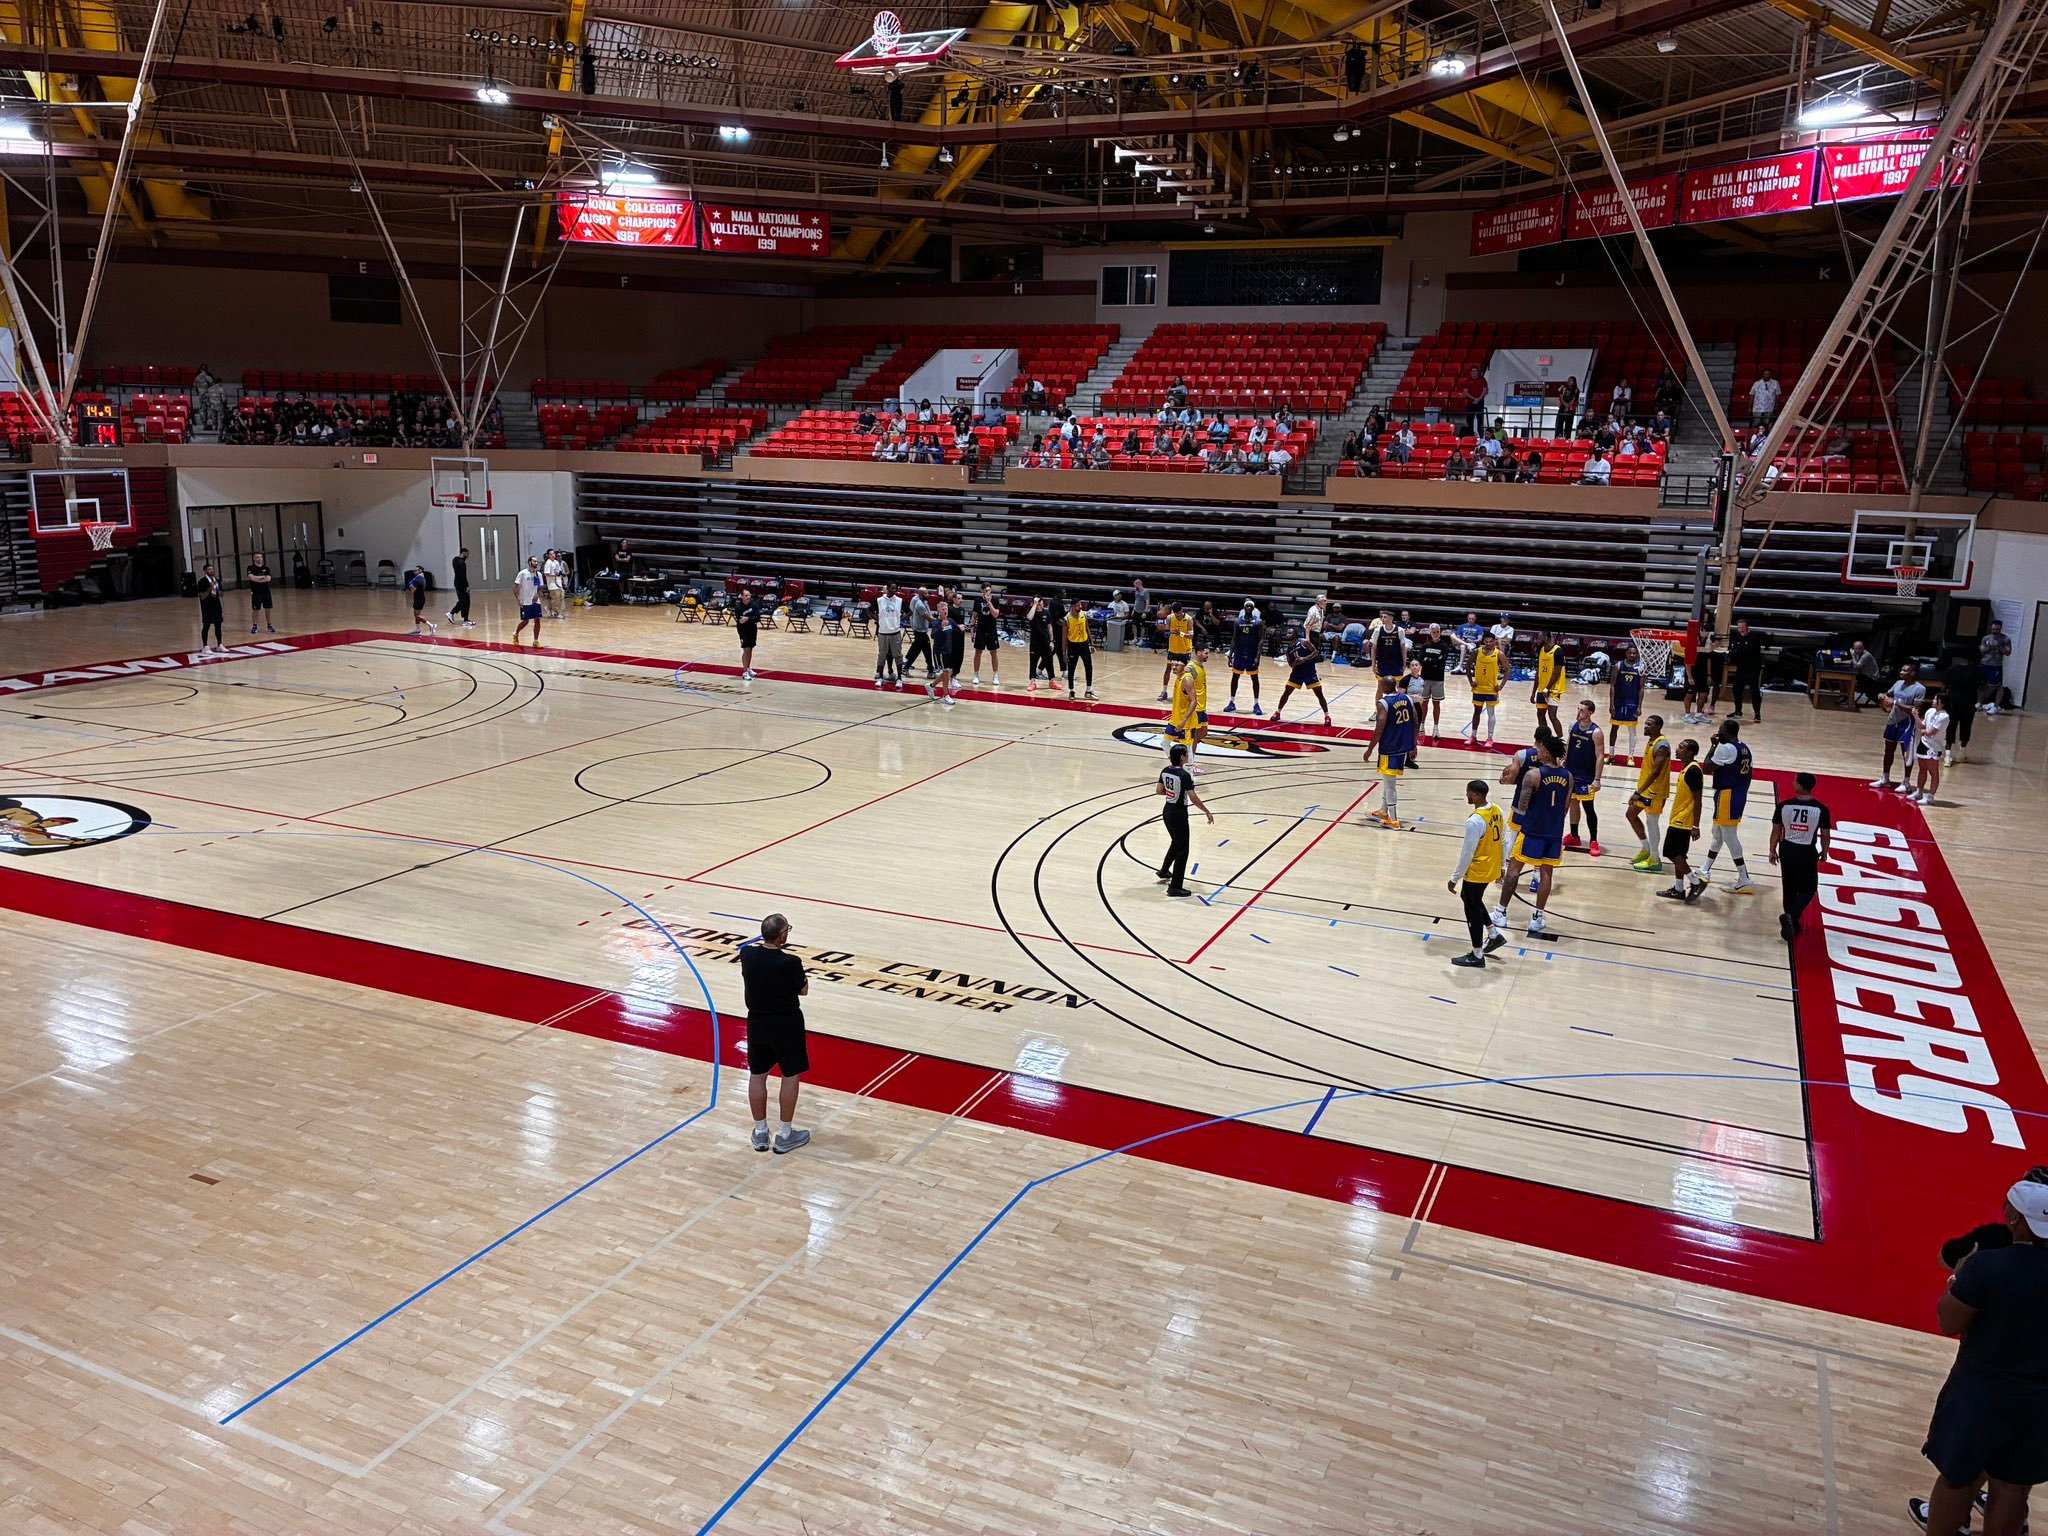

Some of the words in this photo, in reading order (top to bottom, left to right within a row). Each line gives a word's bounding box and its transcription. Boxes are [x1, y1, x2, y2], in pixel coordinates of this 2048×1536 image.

[1712, 172, 1733, 186] NAIA
[1736, 165, 1780, 182] NATIONAL
[1834, 158, 1895, 179] VOLLEYBALL
[1883, 169, 1909, 185] 1997
[1691, 184, 1742, 201] VOLLEYBALL
[1746, 175, 1801, 194] CHAMPIONS
[624, 201, 683, 214] COLLEGIATE
[1576, 203, 1618, 220] VOLLEYBALL
[578, 212, 612, 226] RUGBY
[617, 216, 677, 229] CHAMPIONS
[731, 210, 753, 223] NAIA
[758, 212, 801, 226] NATIONAL
[1609, 214, 1628, 226] 1995
[710, 222, 767, 237] VOLLEYBALL
[770, 226, 823, 240] CHAMPIONS
[758, 238, 777, 250] 1991
[359, 261, 368, 274] E
[1819, 267, 1831, 280] K
[621, 276, 629, 288] F
[1555, 272, 1565, 286] J
[1014, 282, 1023, 295] H
[86, 405, 112, 417] 14.9
[1384, 638, 1393, 646] 22
[1624, 674, 1634, 682] 99
[1395, 708, 1410, 725] 20
[1575, 739, 1582, 749] 2
[1740, 758, 1750, 775] 23
[1165, 776, 1174, 791] 83
[1551, 790, 1556, 807] 1
[1792, 808, 1809, 824] 76
[810, 950, 856, 967] Q.
[878, 962, 1095, 1010] CANNON
[857, 979, 1015, 1013] CENTER
